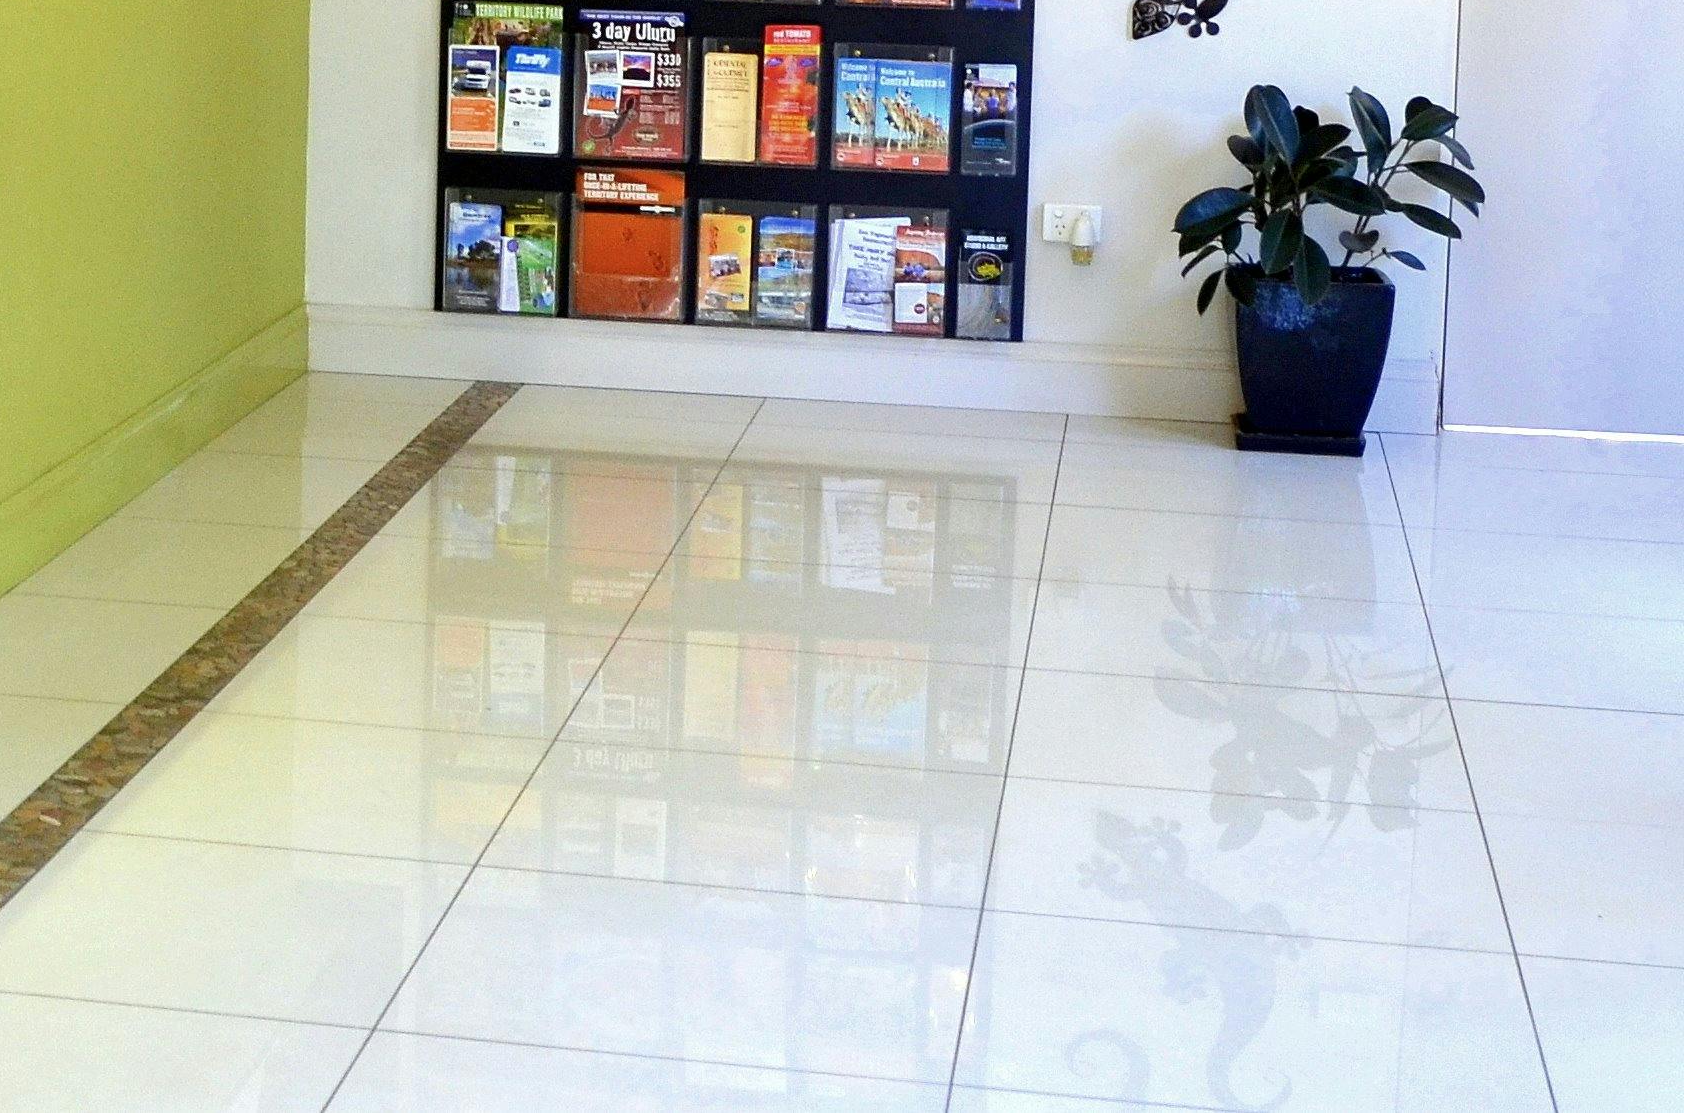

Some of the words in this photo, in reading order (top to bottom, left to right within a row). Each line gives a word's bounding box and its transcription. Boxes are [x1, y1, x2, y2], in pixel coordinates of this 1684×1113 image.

[476, 3, 512, 17] TERRITORY
[514, 4, 544, 19] WILDLIFE
[592, 22, 602, 40] 3
[605, 22, 632, 42] day
[636, 22, 676, 43] Uluru
[515, 53, 551, 68] Thrifty
[657, 52, 682, 67] $330
[656, 72, 682, 88] $355
[880, 75, 910, 86] Central
[909, 77, 947, 88] Australia
[583, 190, 619, 199] TERRITORY
